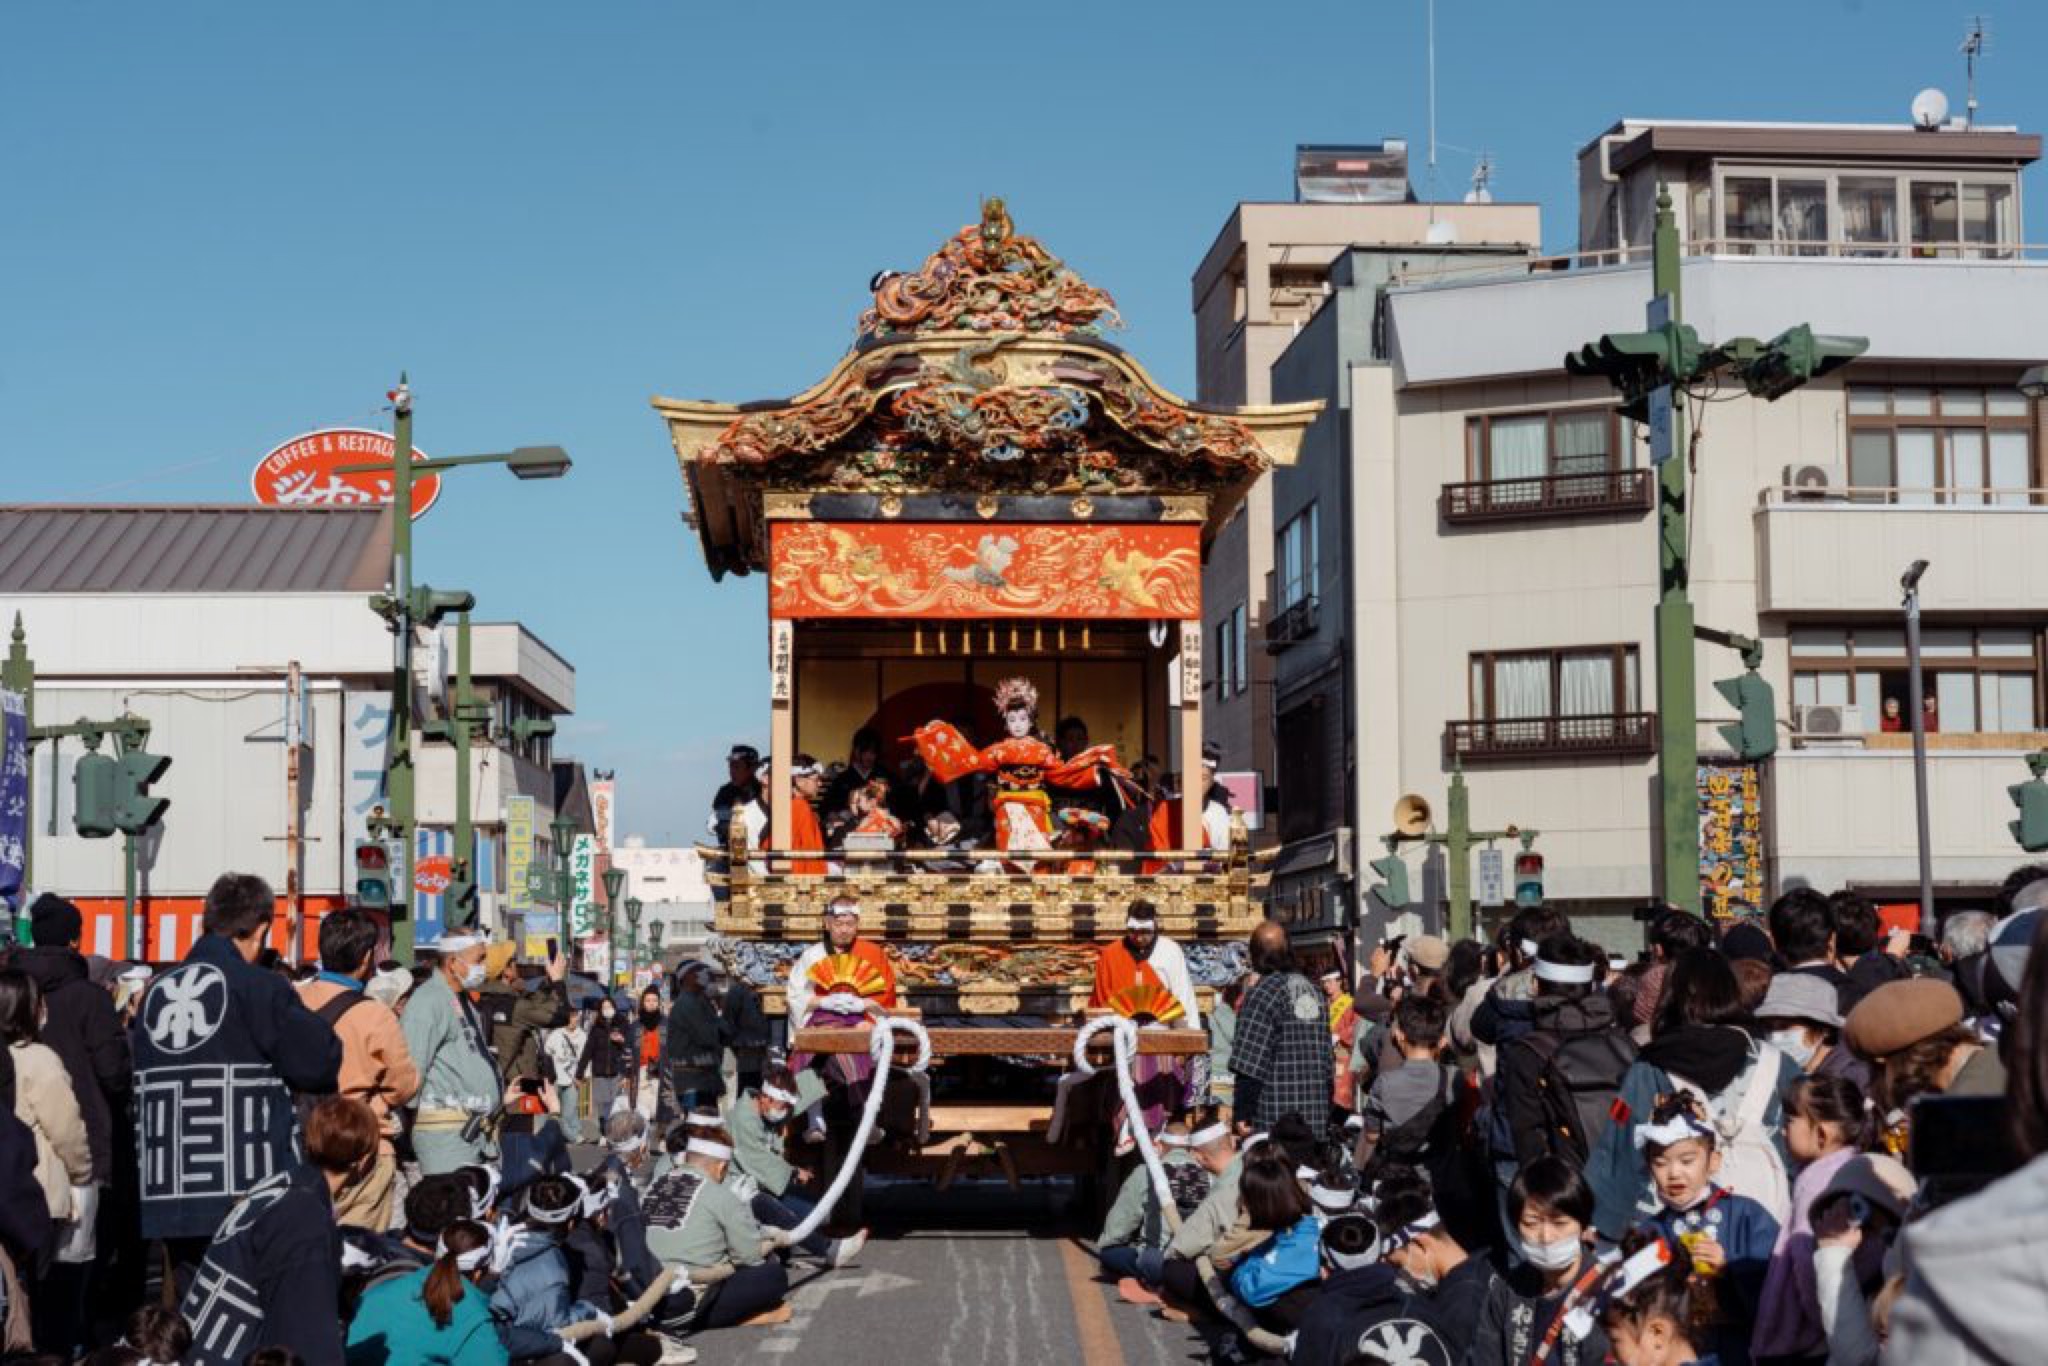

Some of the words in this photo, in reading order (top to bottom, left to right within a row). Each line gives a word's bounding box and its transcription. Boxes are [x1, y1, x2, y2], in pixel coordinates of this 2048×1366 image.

[265, 437, 319, 475] COFFEE
[322, 435, 333, 452] &
[574, 836, 595, 934] メガネサロン
